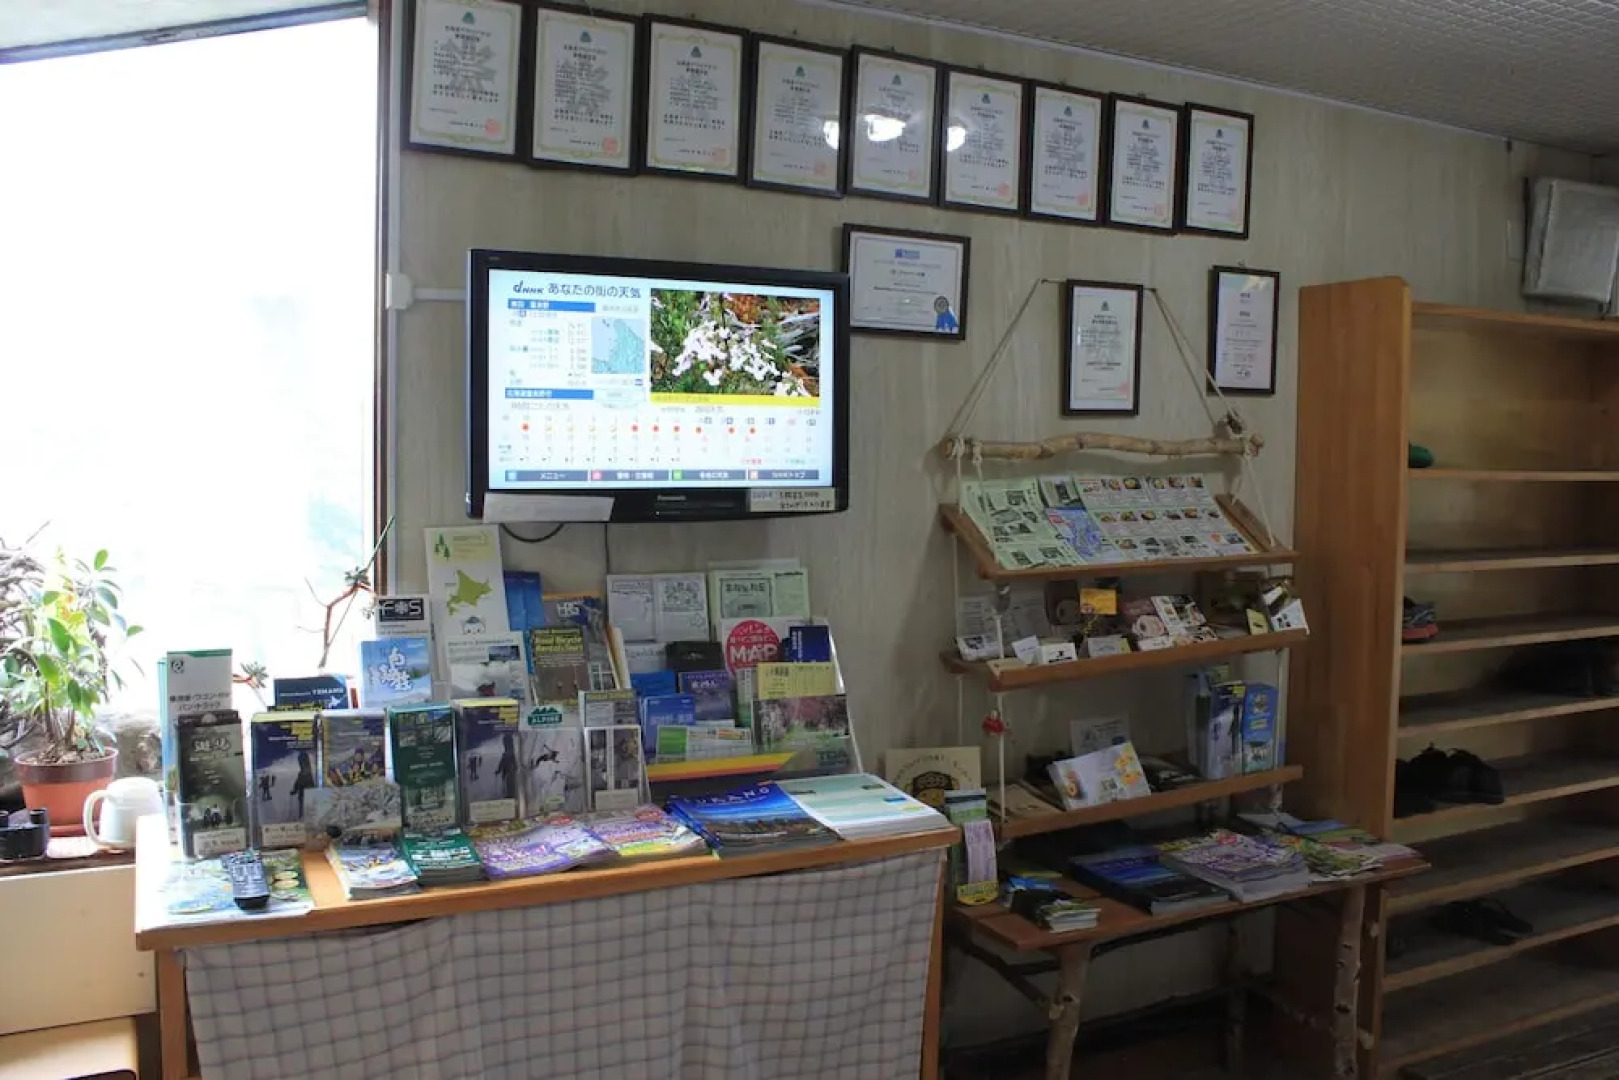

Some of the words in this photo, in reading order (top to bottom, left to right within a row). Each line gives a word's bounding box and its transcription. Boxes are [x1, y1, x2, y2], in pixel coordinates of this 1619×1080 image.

[548, 283, 641, 299] あなたの街の天気
[730, 645, 778, 662] MAP
